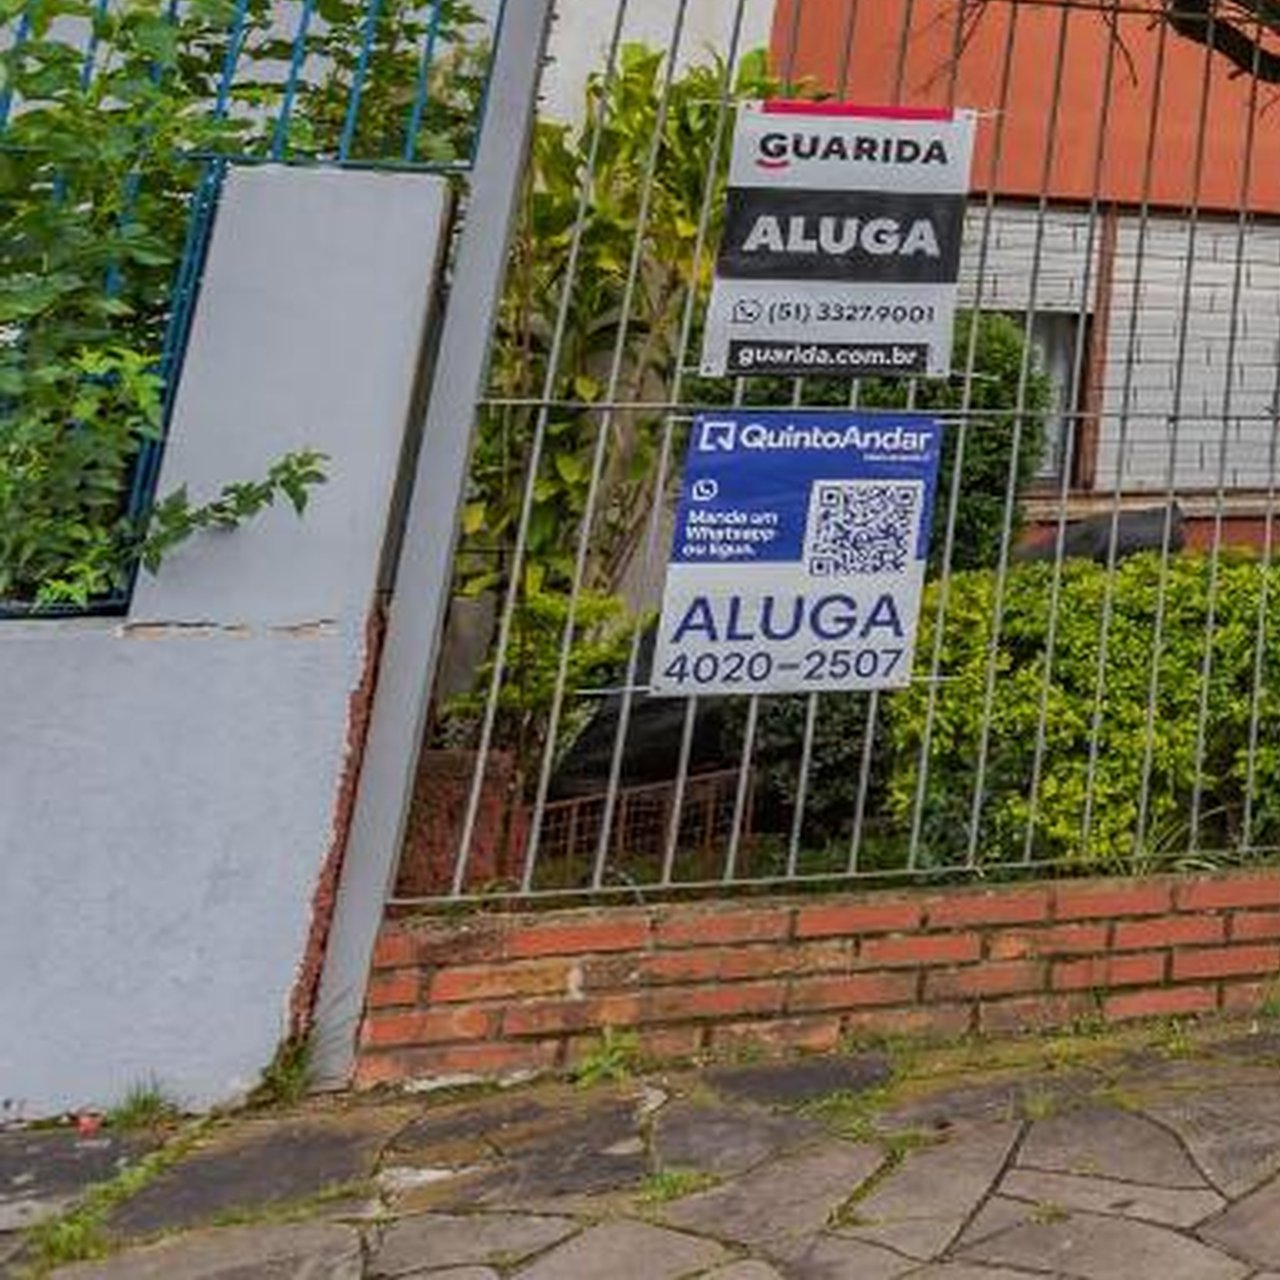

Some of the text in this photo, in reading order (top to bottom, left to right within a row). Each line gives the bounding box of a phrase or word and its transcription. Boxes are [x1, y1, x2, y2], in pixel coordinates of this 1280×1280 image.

[759, 133, 949, 165] GUARIDA
[742, 216, 941, 256] ALUGA
[769, 303, 811, 324] (51)
[738, 346, 918, 366] guarida.com.br
[740, 424, 933, 451] QuintoAndar
[670, 593, 905, 643] ALUGA
[663, 649, 904, 684] 4020-2507
